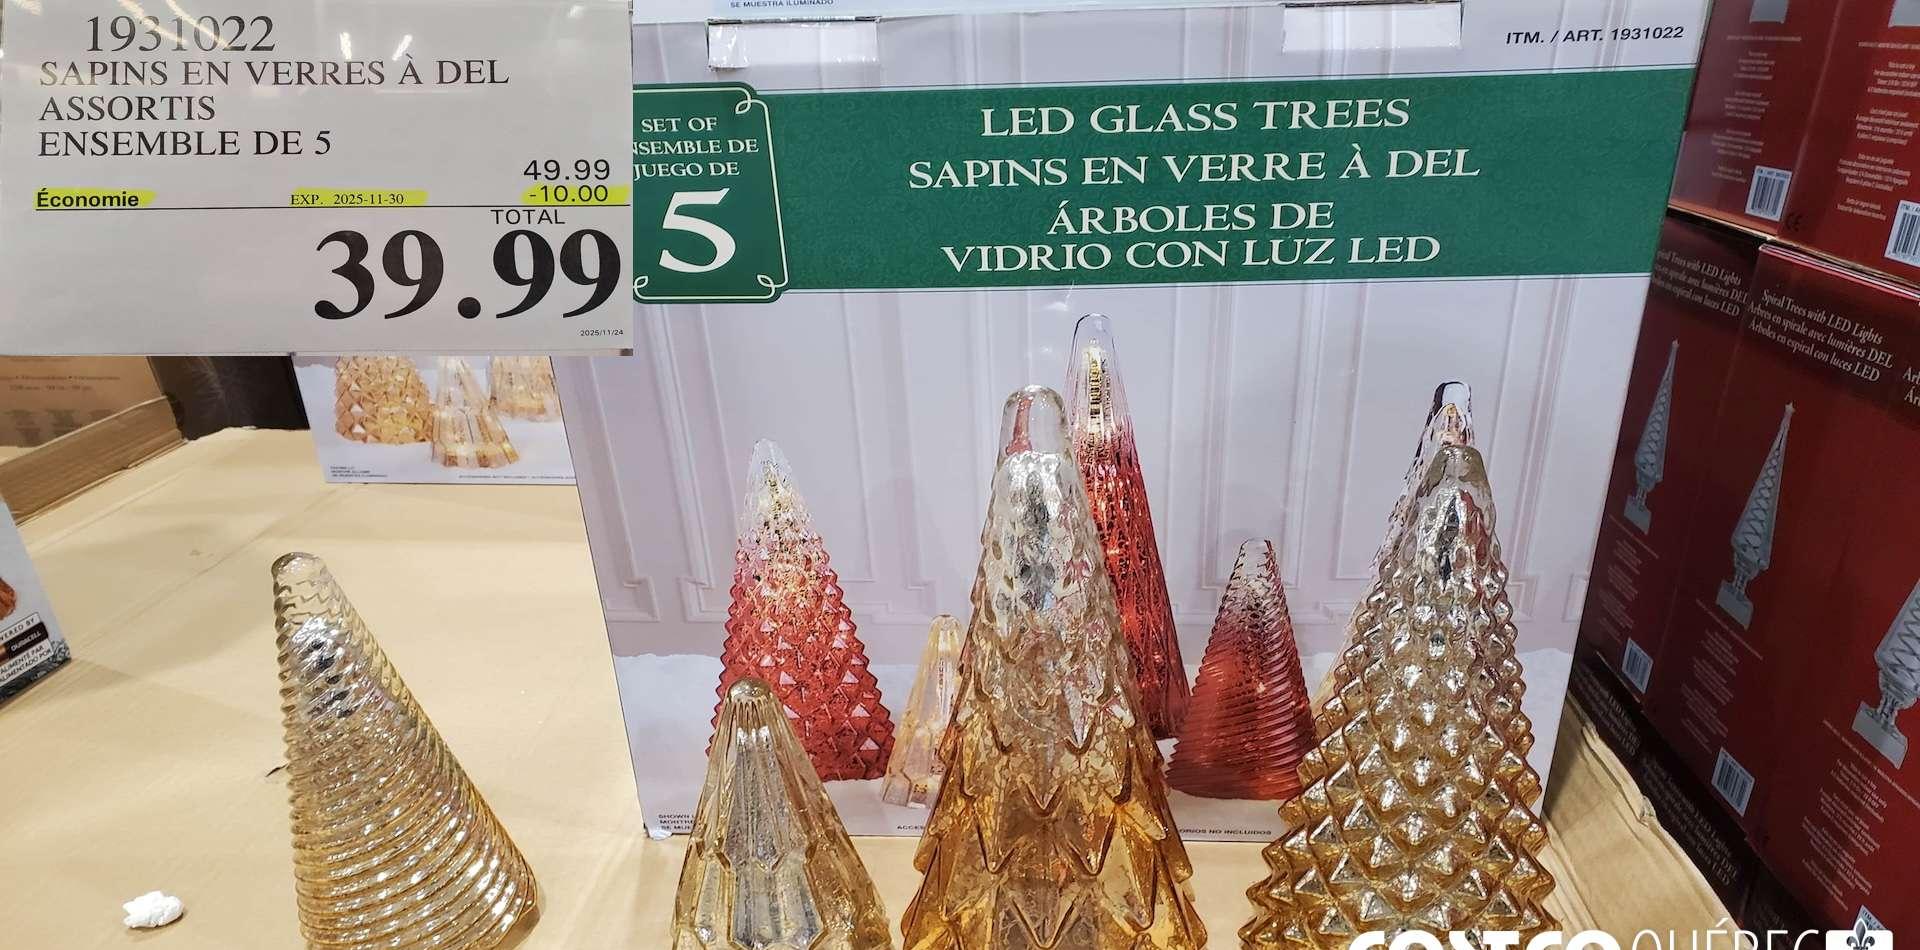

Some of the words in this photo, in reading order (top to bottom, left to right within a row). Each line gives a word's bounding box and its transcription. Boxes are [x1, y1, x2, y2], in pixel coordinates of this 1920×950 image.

[86, 15, 275, 54] 1931022
[1505, 31, 1545, 46] ITM.
[1550, 30, 1560, 45] /
[1564, 29, 1604, 44] ART.
[1611, 25, 1686, 42] 1931022
[39, 60, 169, 87] SAPINS
[183, 60, 230, 86] EN
[245, 59, 386, 86] VERRES
[399, 53, 424, 85] À
[436, 60, 511, 85] DEL
[38, 95, 216, 122] ASSORTIS
[981, 106, 1075, 137] LED
[1090, 102, 1238, 134] GLASS
[1253, 98, 1411, 130] TREES
[641, 117, 681, 133] SET
[688, 116, 718, 132] OF
[38, 131, 240, 158] ENSEMBLE
[252, 131, 304, 156] DE
[315, 131, 332, 156] 5
[728, 138, 760, 154] DE
[523, 159, 612, 182] 49.99
[633, 162, 703, 180] JUEGO
[709, 161, 740, 177] DE
[909, 158, 1068, 189] SAPINS
[1081, 155, 1148, 186] EN
[1162, 150, 1327, 183] VERRE
[1339, 144, 1371, 179] À
[1386, 149, 1481, 179] DEL
[36, 188, 140, 208] Économie
[290, 194, 324, 207] EXP.
[333, 193, 405, 207] 2025-11-30
[529, 184, 610, 204] -10.00
[491, 209, 567, 226] TOTAL
[1047, 200, 1257, 236] ÁRBOLES
[1269, 201, 1335, 230] DE
[659, 187, 737, 274] 5
[941, 242, 1112, 273] VIDRIO
[1125, 240, 1230, 270] CON
[1243, 237, 1336, 268] LUZ
[1348, 235, 1441, 265] LED
[314, 228, 622, 321] 39.99
[1700, 262, 1719, 278] LED
[1718, 267, 1742, 286] Lights
[1729, 287, 1748, 304] DEL
[1720, 300, 1741, 317] LED
[1762, 289, 1786, 309] Spiral
[1785, 295, 1806, 316] Trees
[1806, 308, 1826, 324] with
[1827, 313, 1852, 333] LED
[1851, 322, 1884, 346] Lights
[580, 328, 625, 338] 2025/11/24
[1748, 301, 1772, 320] Arbres
[1772, 311, 1782, 324] en
[1782, 317, 1808, 336] spirale
[1807, 328, 1826, 343] avec
[1826, 332, 1867, 359] lumières
[1866, 350, 1894, 369] DEL
[1776, 334, 1787, 344] en
[1786, 339, 1815, 357] espiral
[1814, 348, 1830, 363] con
[1829, 353, 1853, 372] luces
[1852, 363, 1881, 382] LED
[31, 645, 44, 656] PAR
[39, 649, 52, 659] POR
